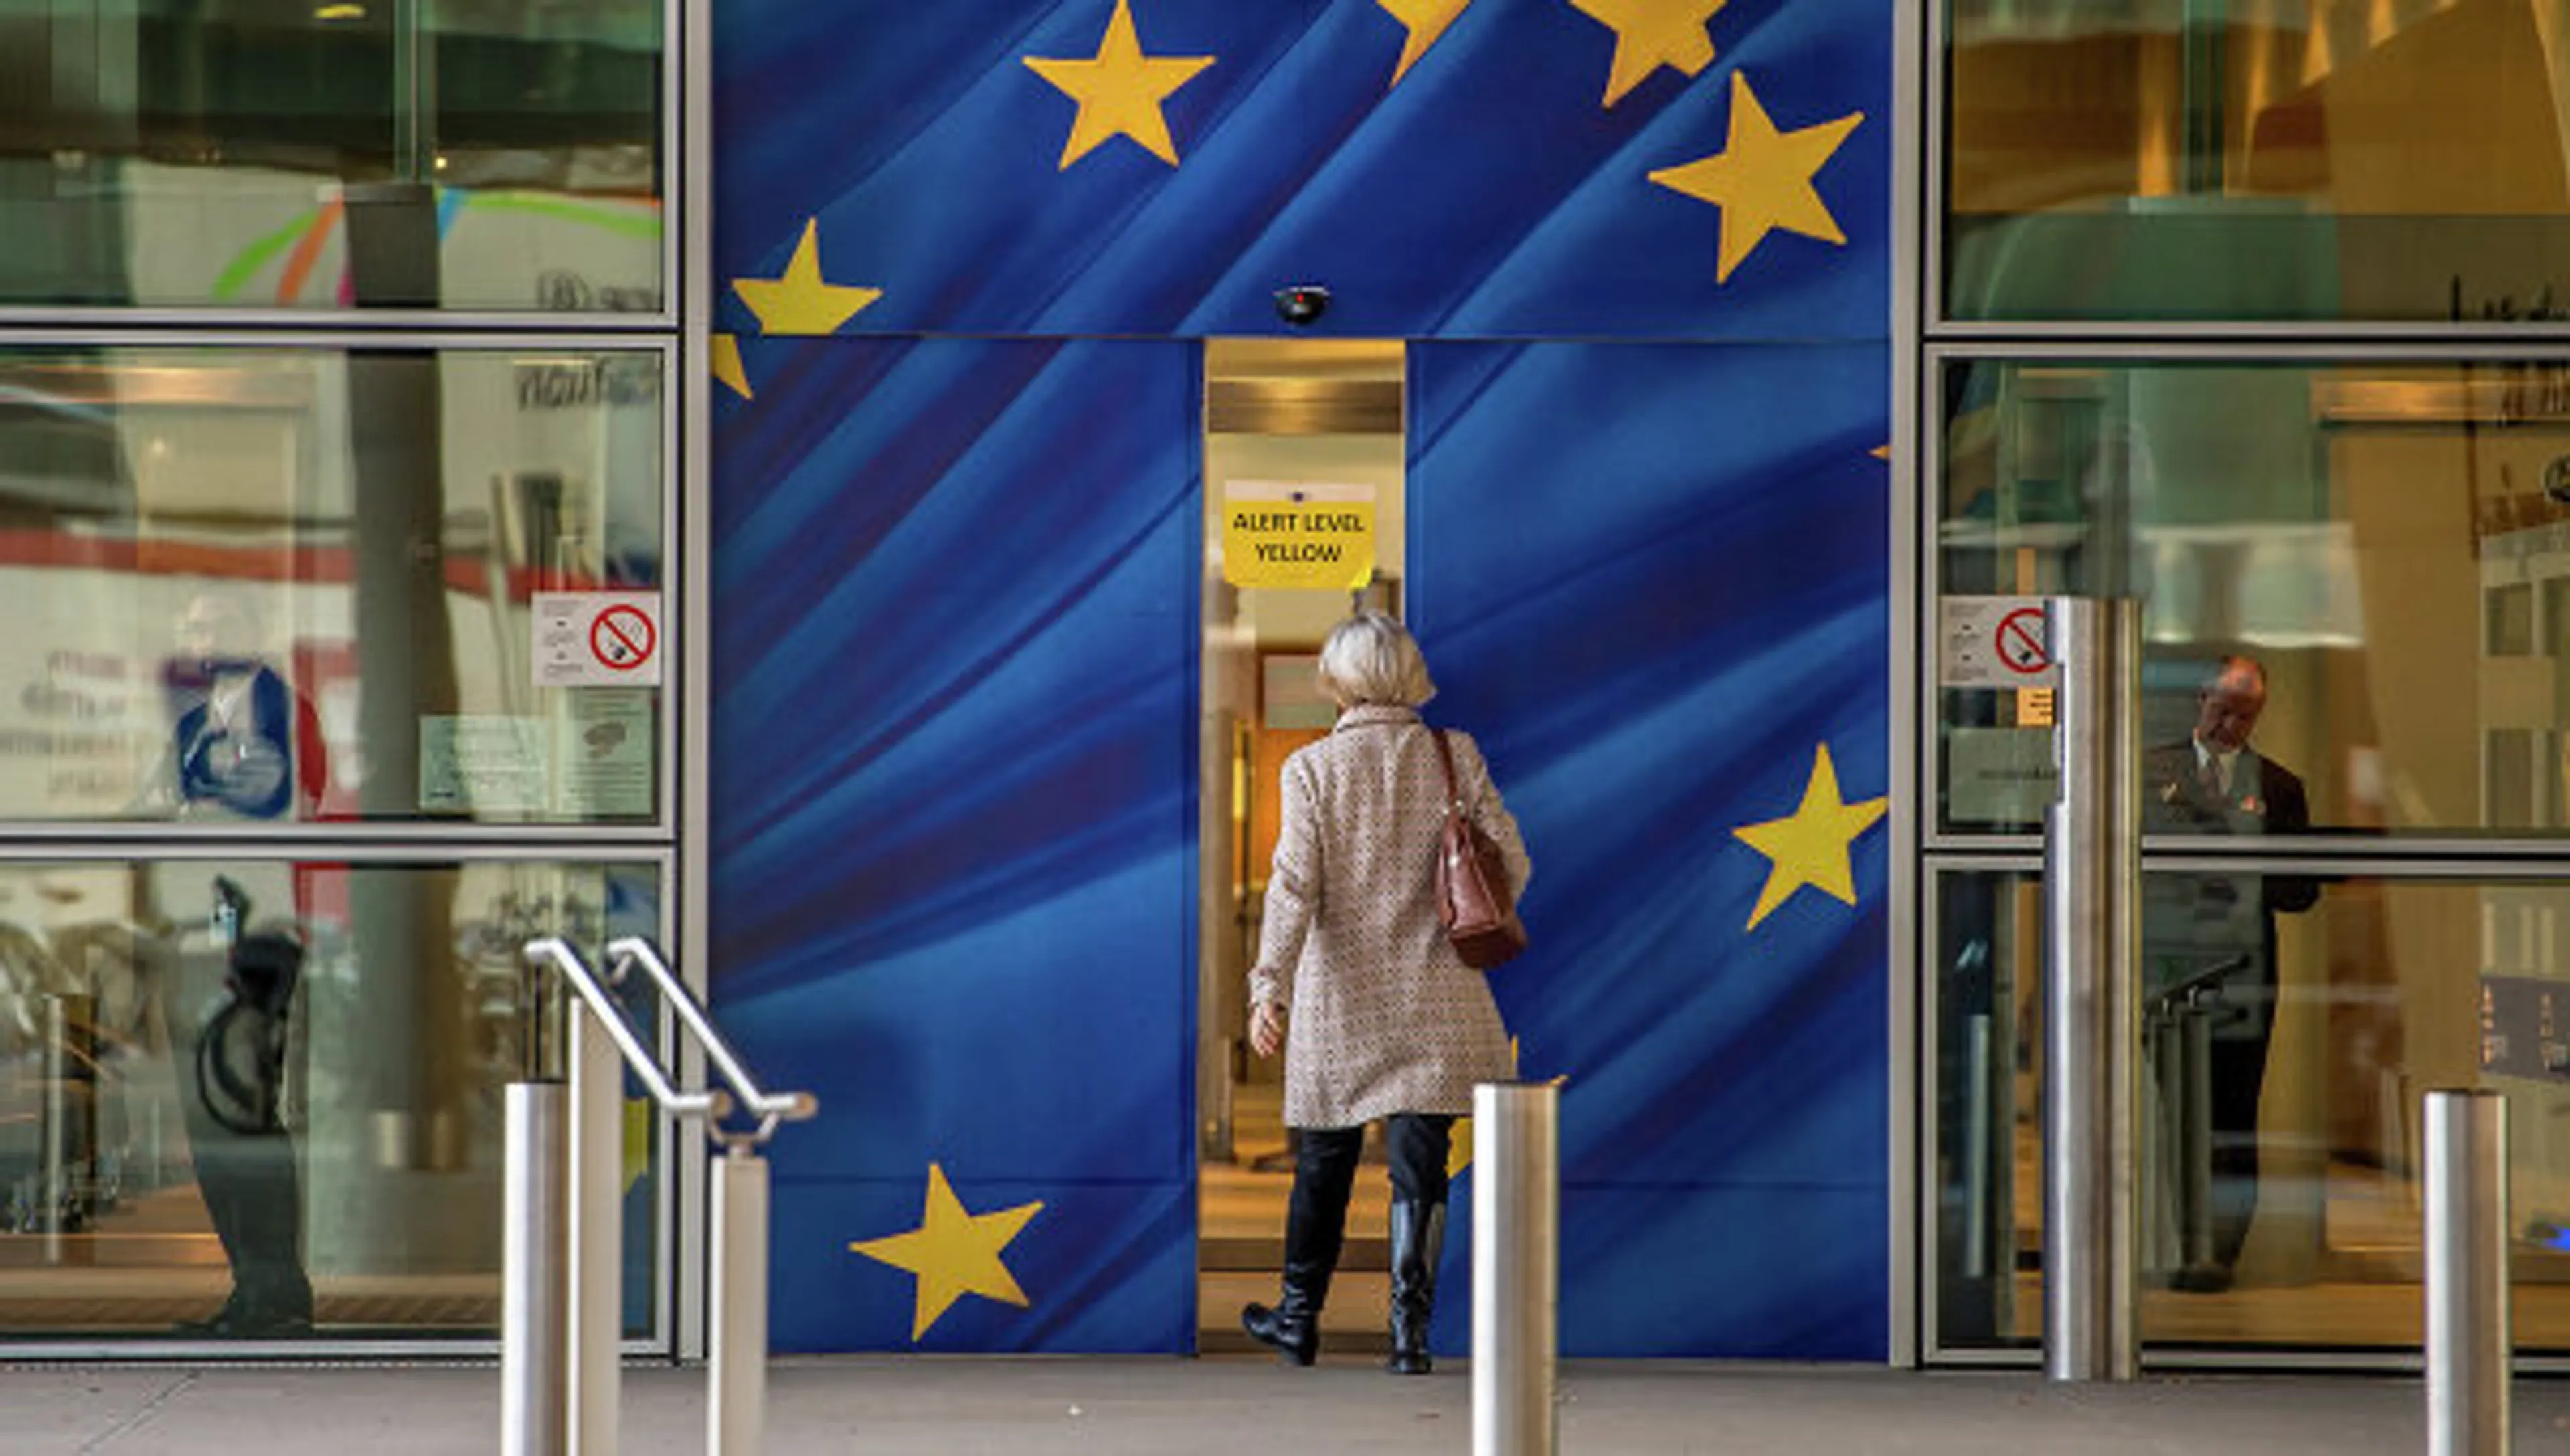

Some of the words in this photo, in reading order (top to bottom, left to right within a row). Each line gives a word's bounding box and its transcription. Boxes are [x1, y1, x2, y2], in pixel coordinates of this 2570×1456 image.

[1233, 513, 1298, 531] ALERT
[1304, 513, 1365, 532] LEVEL
[1255, 543, 1342, 562] YELLOW
